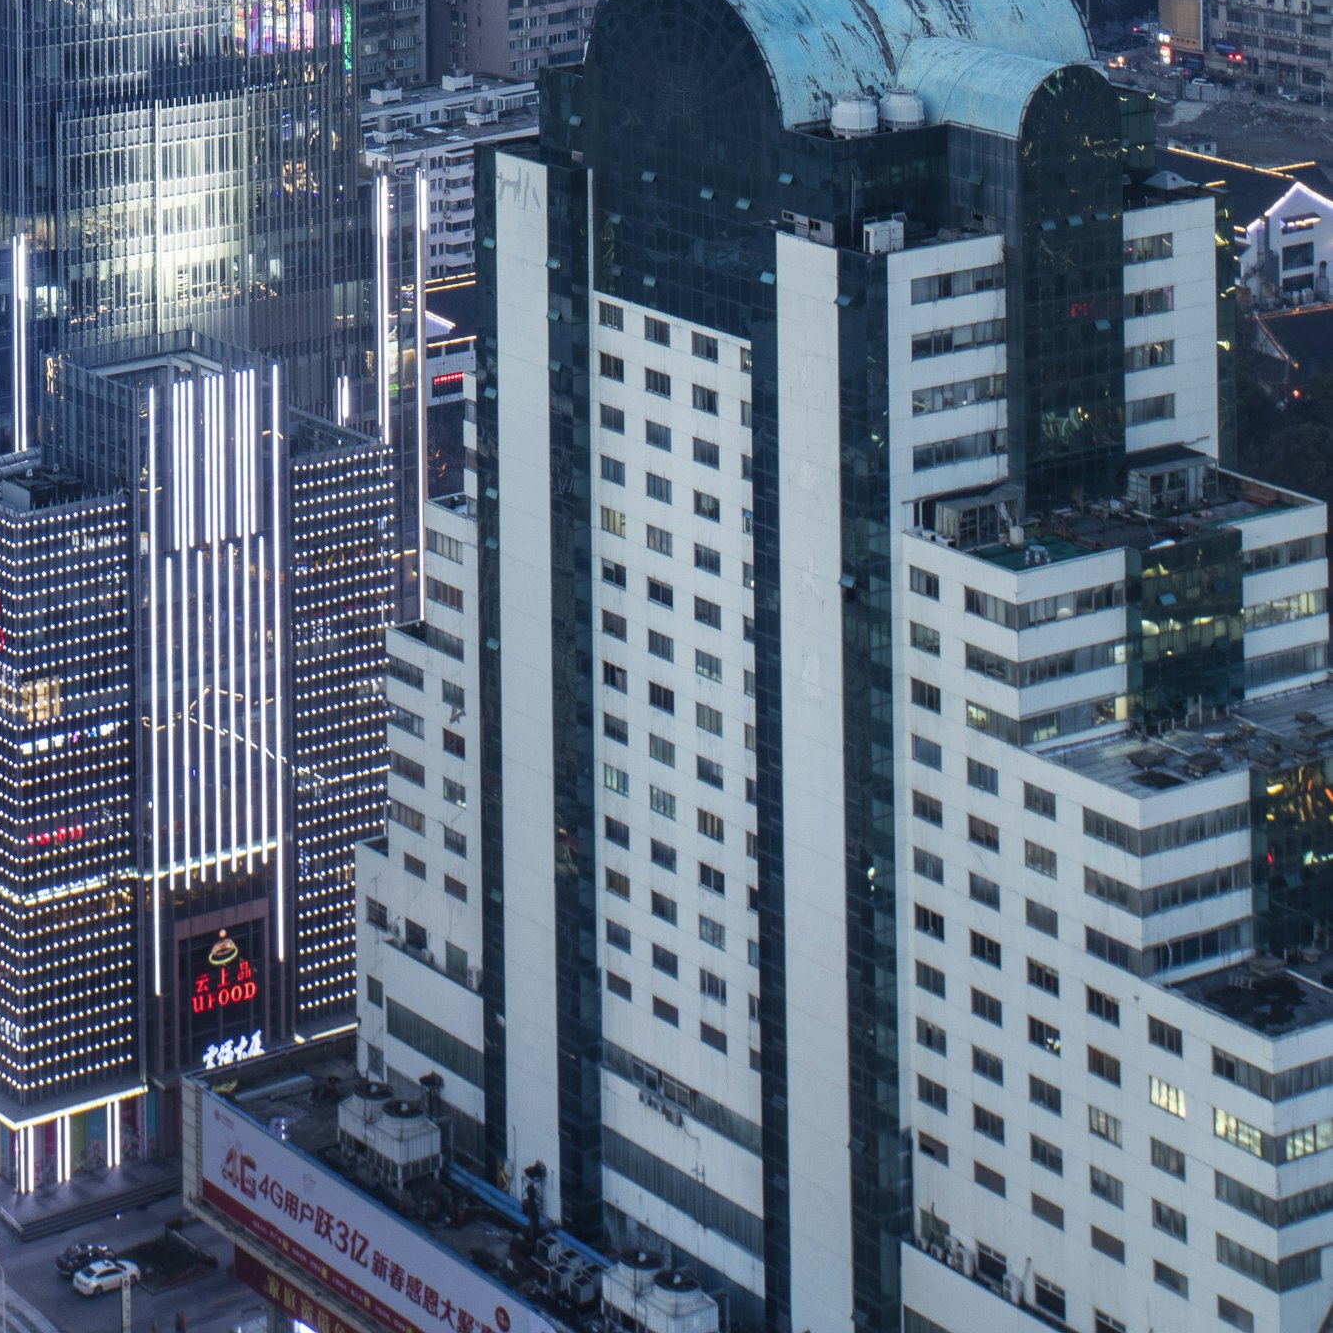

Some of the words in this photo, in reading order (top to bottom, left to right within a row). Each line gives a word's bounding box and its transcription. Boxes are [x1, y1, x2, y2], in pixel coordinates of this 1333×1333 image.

[195, 959, 253, 994] 云上品
[191, 981, 257, 1013] UFOOD
